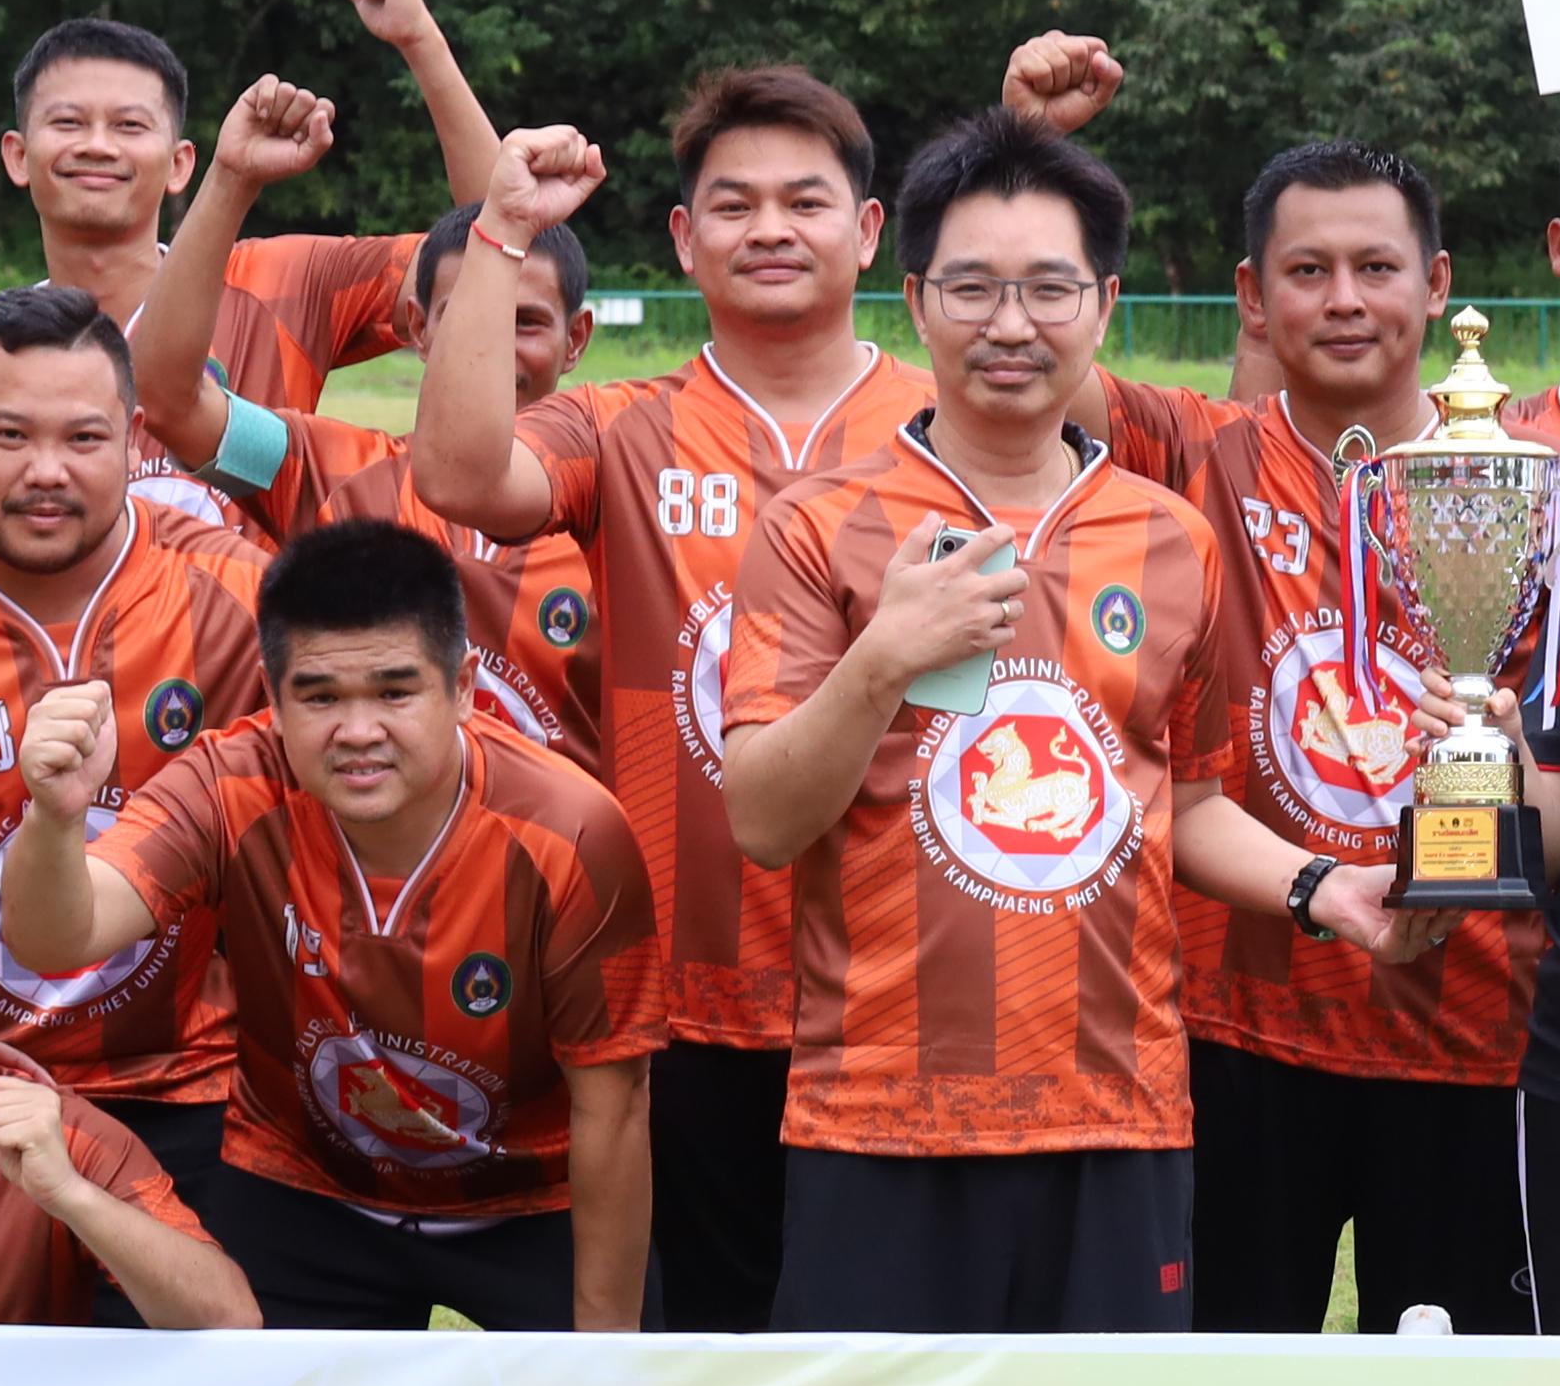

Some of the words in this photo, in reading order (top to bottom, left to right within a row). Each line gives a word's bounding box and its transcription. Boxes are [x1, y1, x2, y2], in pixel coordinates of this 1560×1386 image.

[658, 468, 738, 536] 88
[678, 581, 732, 648] PUBLIC
[1269, 780, 1362, 849] KAMPHAENG
[944, 864, 1054, 914] KAMPHAENG
[1065, 885, 1101, 910] PHET
[88, 989, 131, 1019] PHET
